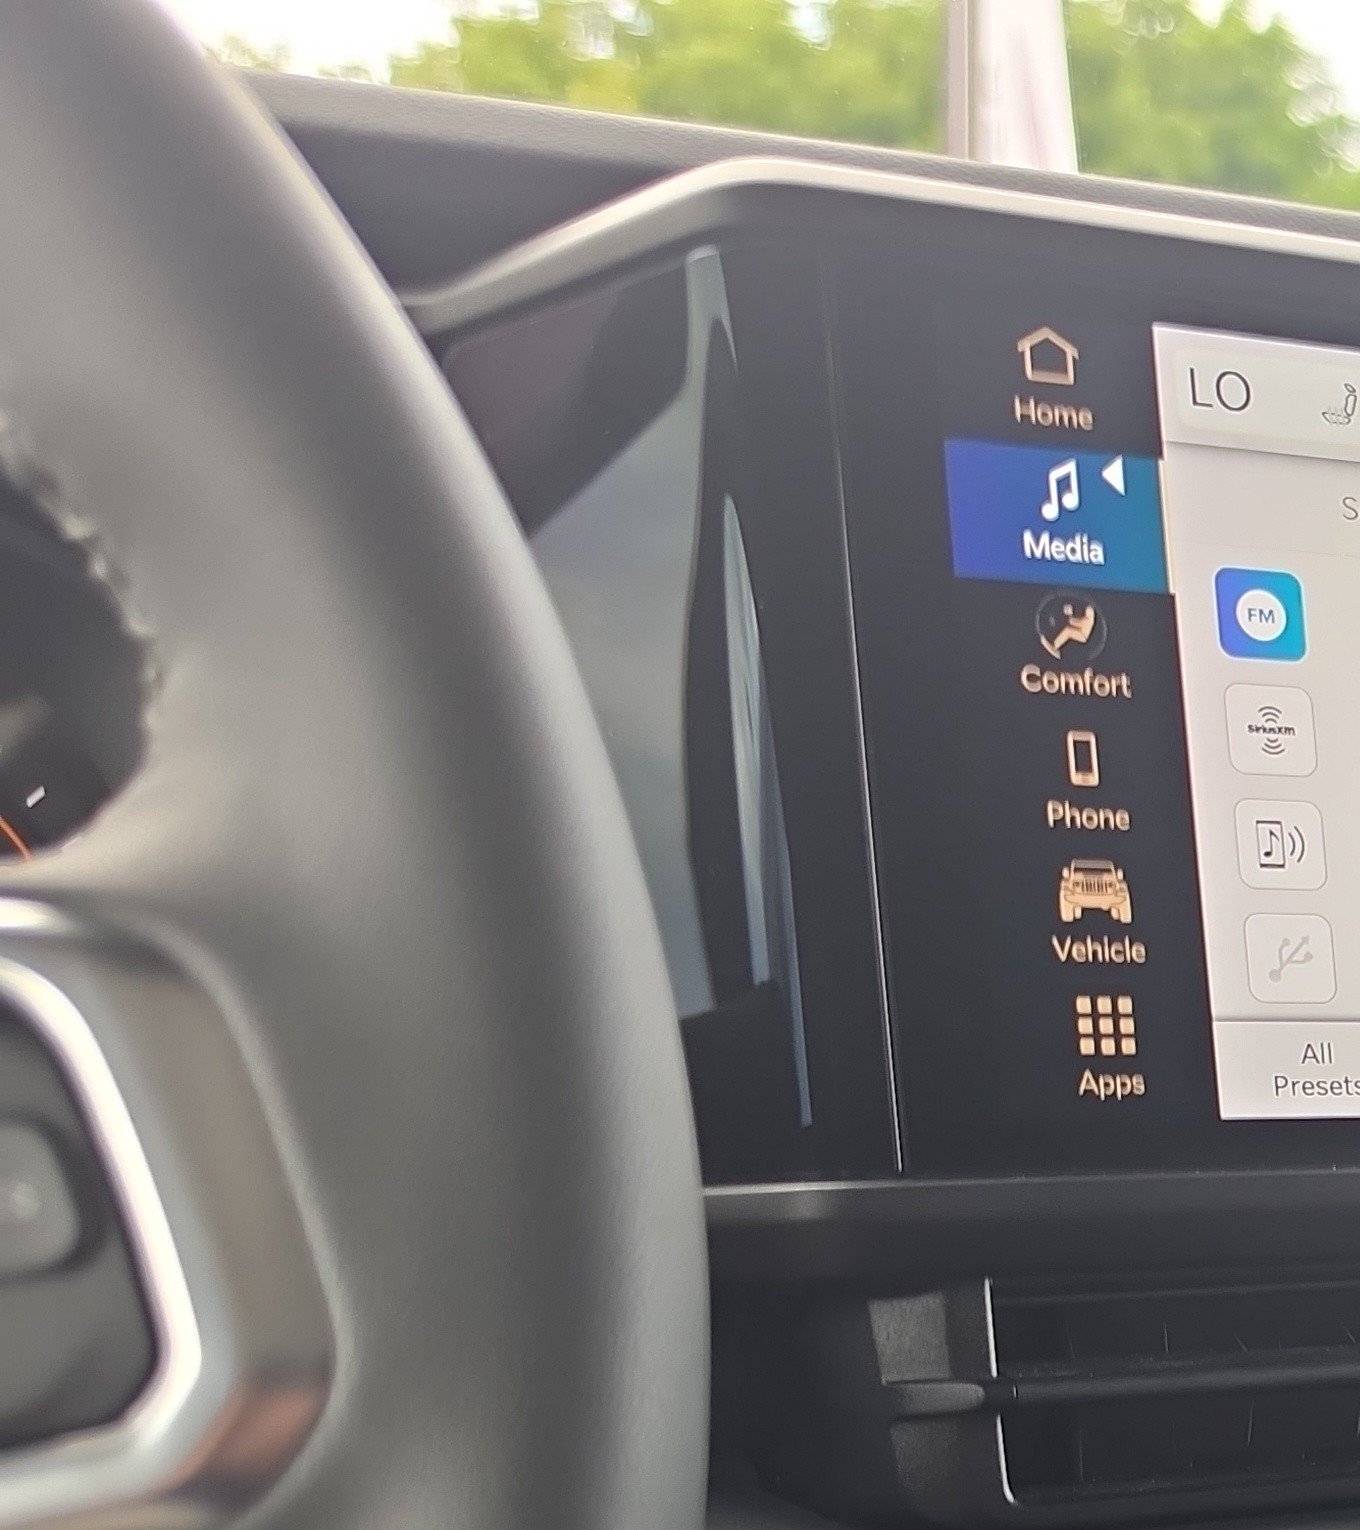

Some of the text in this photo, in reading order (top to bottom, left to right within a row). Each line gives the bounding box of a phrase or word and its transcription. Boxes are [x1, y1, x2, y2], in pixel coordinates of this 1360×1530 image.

[1188, 367, 1252, 412] LO
[1013, 396, 1094, 432] Home
[1022, 529, 1106, 566] Media
[1246, 606, 1277, 626] FM
[1019, 663, 1133, 700] Comfort
[1046, 800, 1131, 832] Phone
[1052, 935, 1147, 965] Vehicle
[1300, 1041, 1334, 1066] All
[1077, 1069, 1147, 1100] Apps
